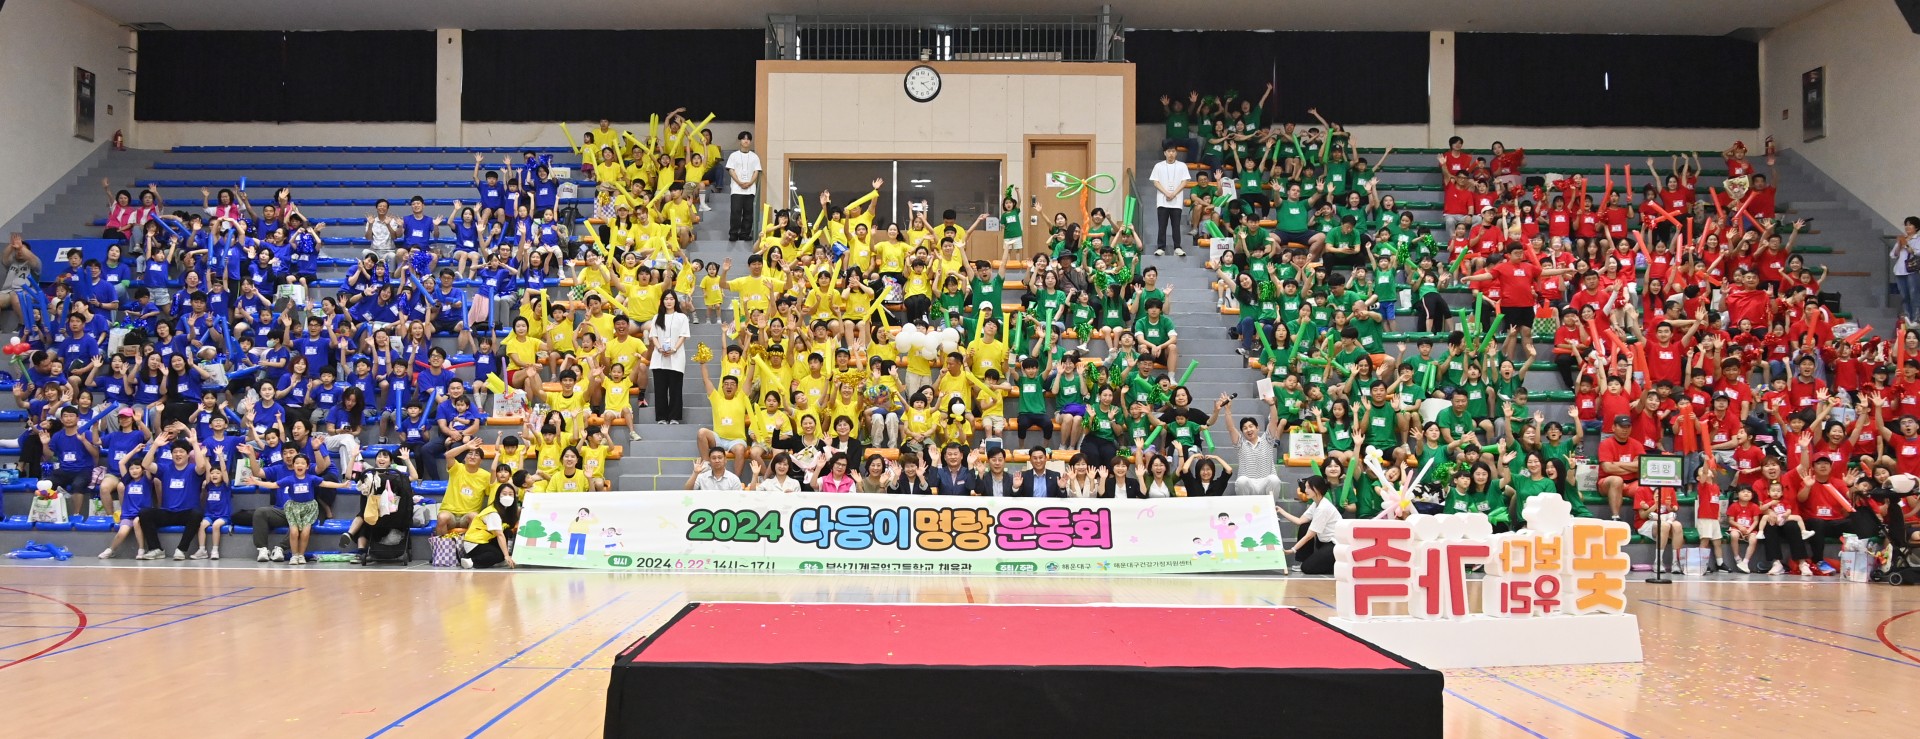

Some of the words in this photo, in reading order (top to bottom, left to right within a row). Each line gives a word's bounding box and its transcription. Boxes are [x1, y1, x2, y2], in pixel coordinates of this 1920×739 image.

[686, 508, 784, 542] 2024
[789, 505, 910, 550] 다둥이
[914, 507, 995, 551] 명랑
[995, 507, 1113, 550] 운동회
